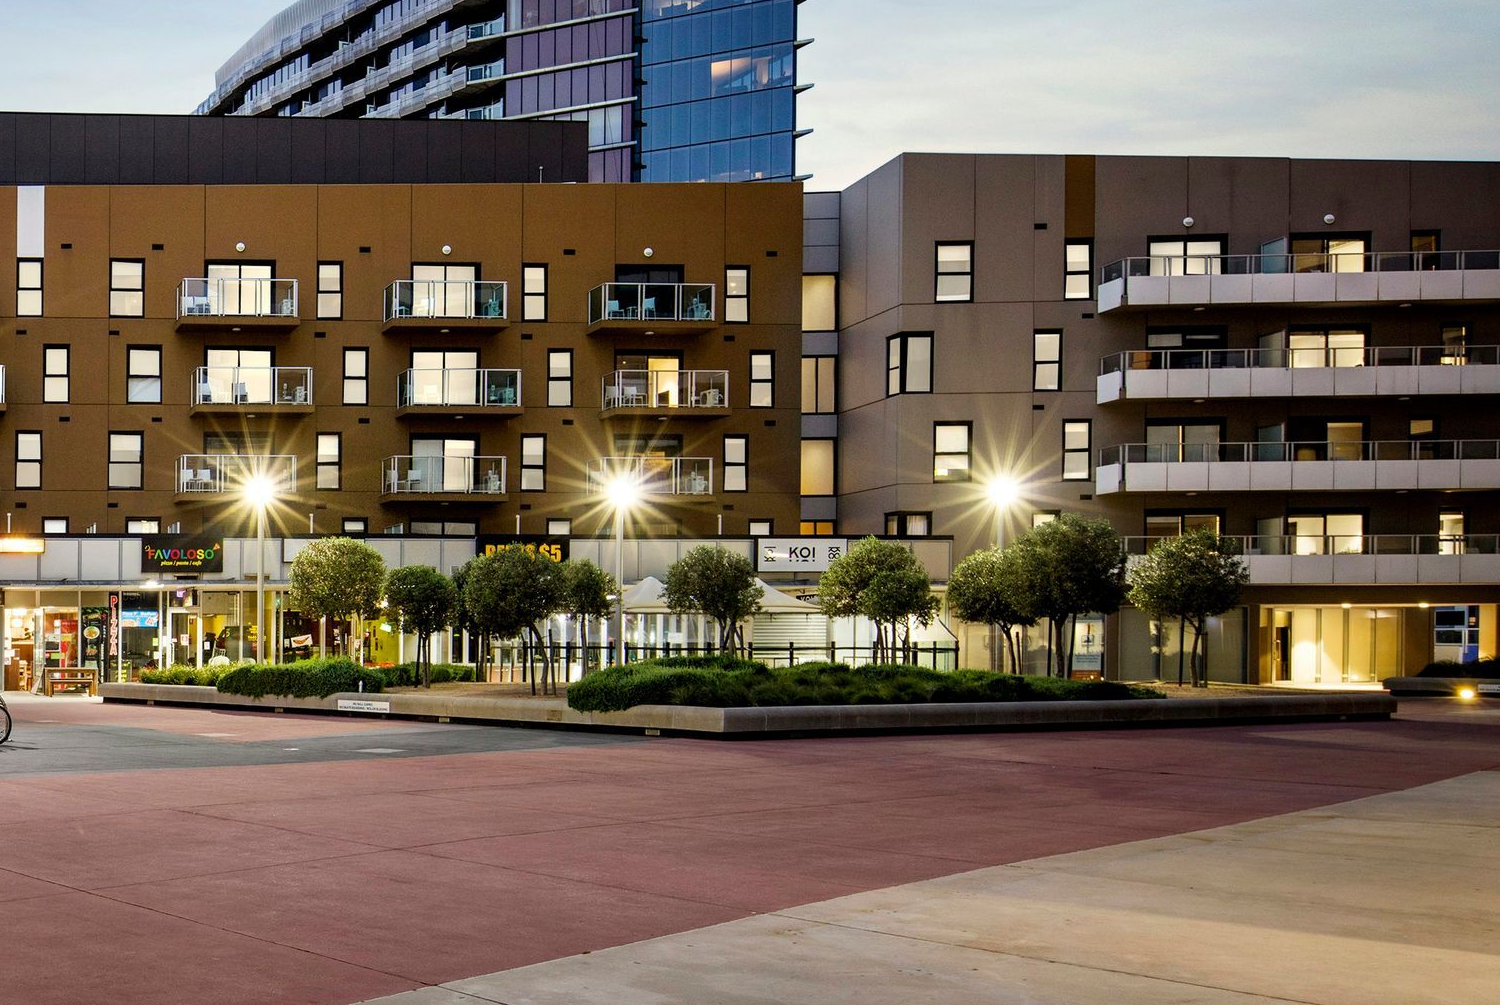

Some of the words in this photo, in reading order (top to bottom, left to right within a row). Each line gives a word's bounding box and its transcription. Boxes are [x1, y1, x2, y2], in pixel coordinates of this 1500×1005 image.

[148, 548, 215, 560] FAVOLOSO
[789, 546, 816, 559] KOI
[110, 595, 118, 656] PIZZA
